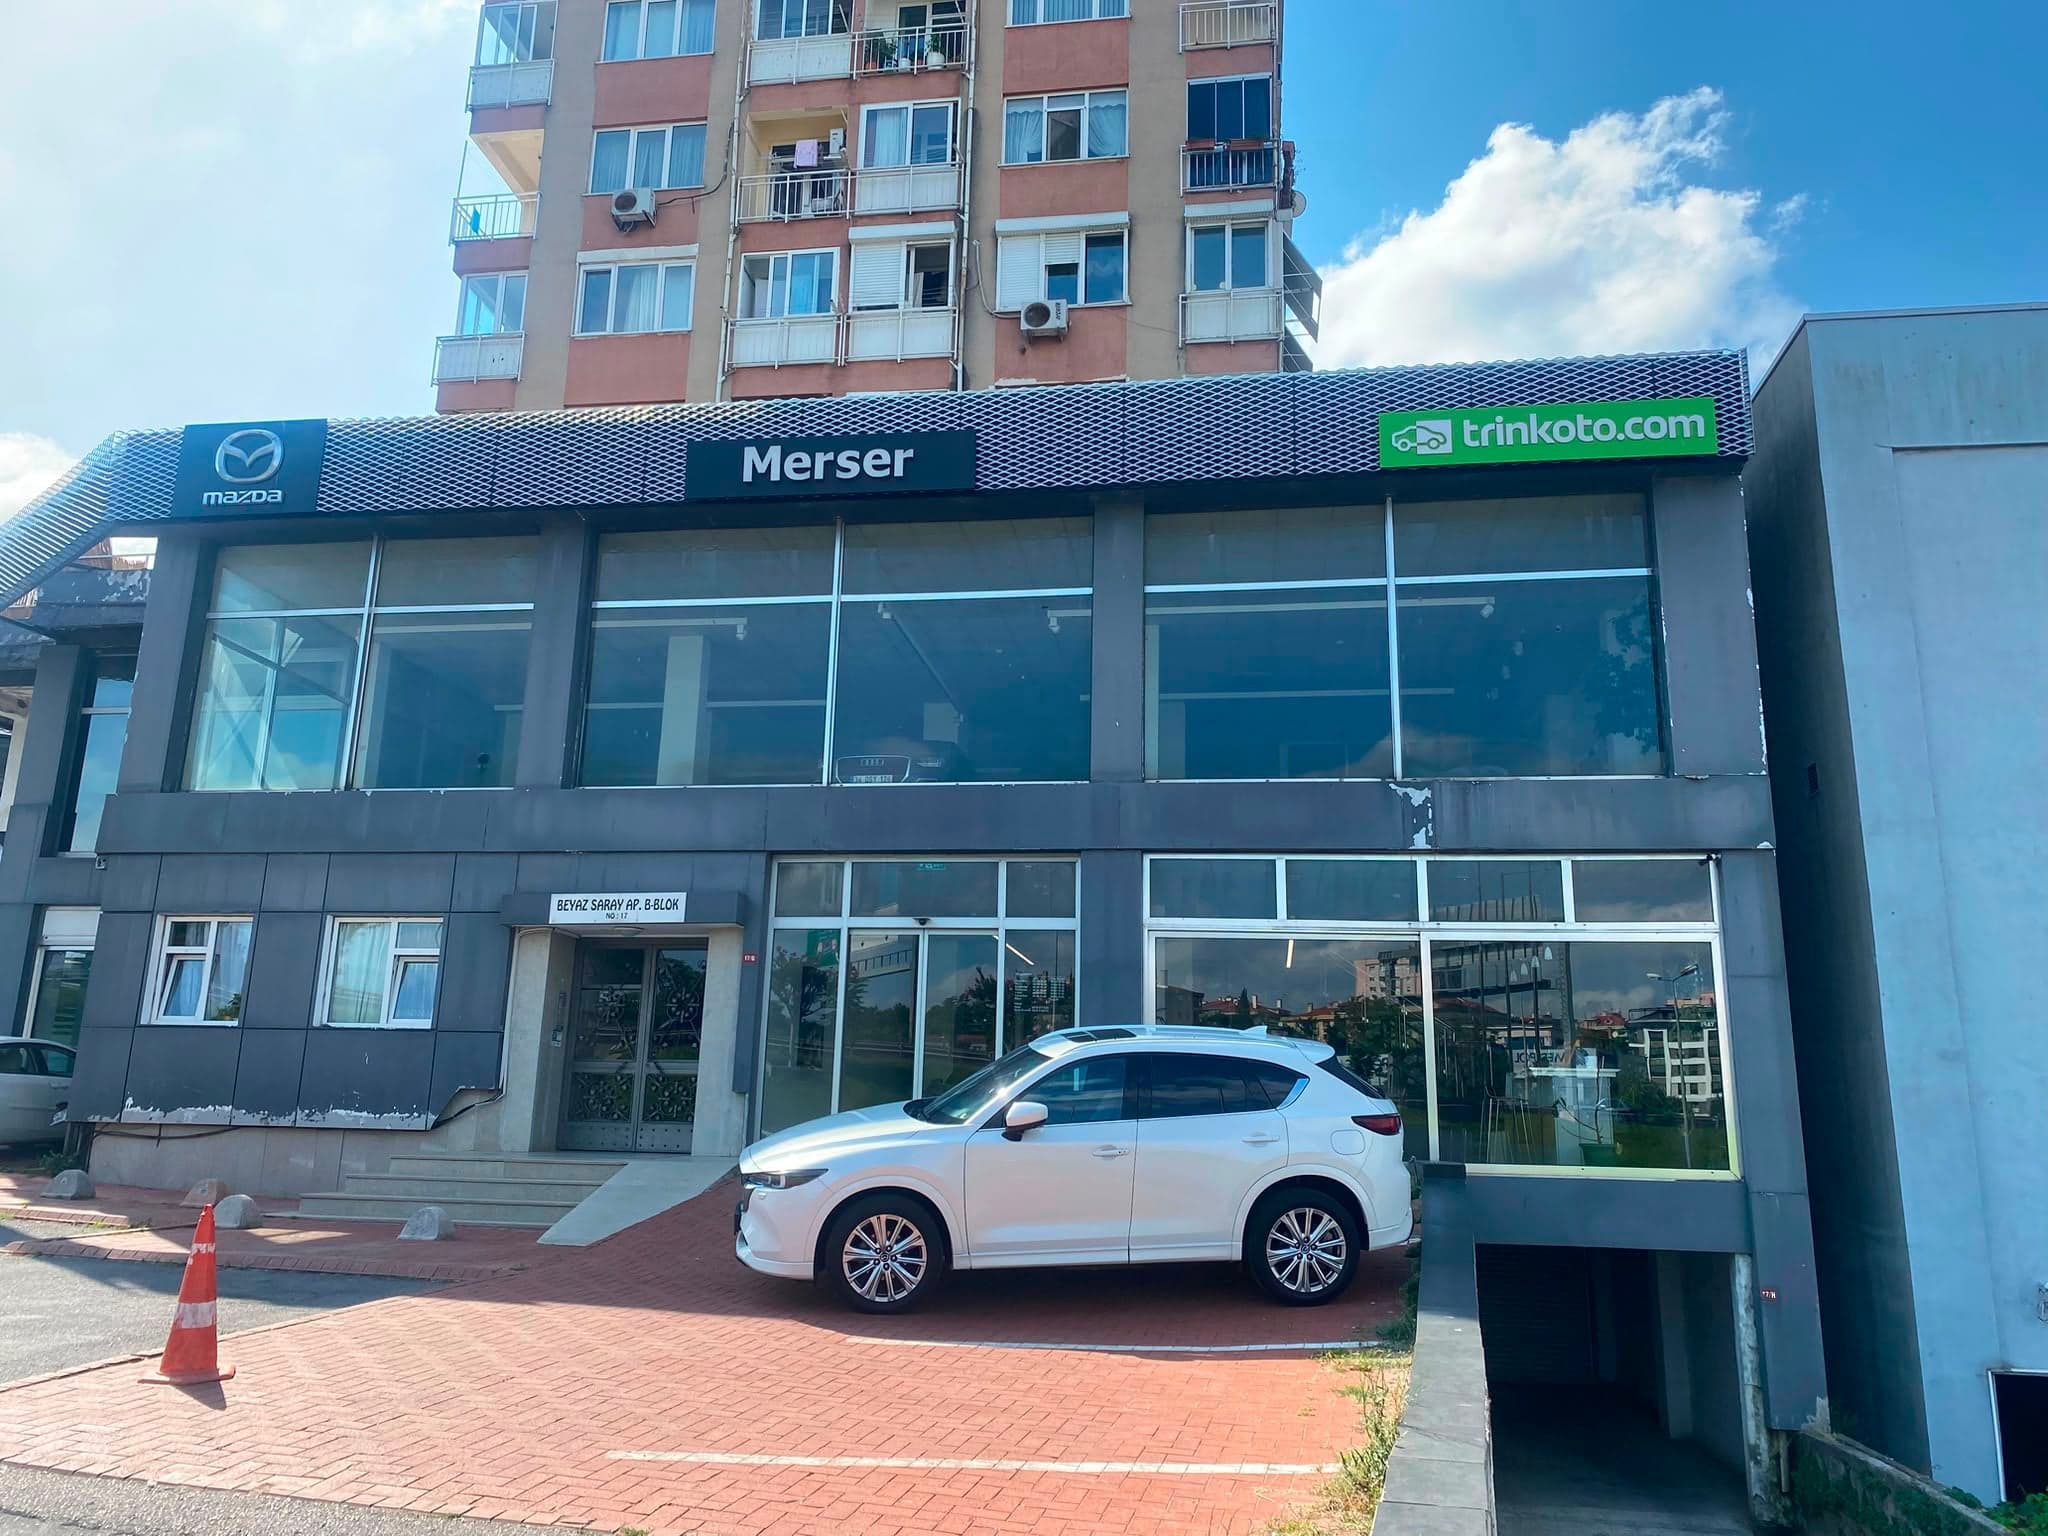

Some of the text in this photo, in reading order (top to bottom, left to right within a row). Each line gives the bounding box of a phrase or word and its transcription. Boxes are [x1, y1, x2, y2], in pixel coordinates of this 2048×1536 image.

[1463, 413, 1705, 448] trinkoto.com
[742, 445, 914, 483] Merser
[557, 898, 680, 912] BEYAZ SARAY AP. B-BLOK
